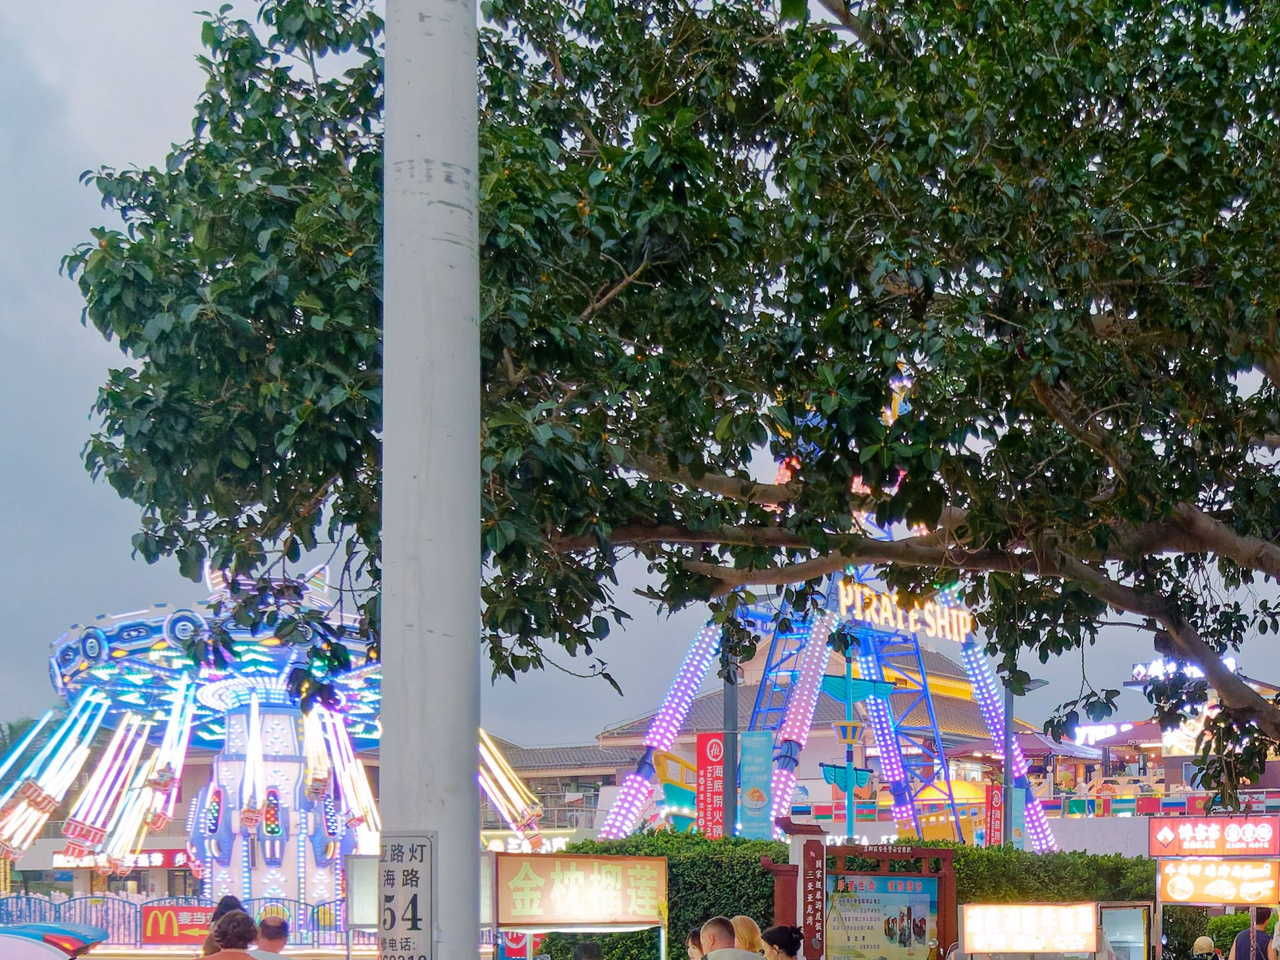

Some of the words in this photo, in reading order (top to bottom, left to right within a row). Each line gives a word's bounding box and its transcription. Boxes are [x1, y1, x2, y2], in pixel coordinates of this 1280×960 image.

[923, 600, 972, 642] SHIP
[712, 765, 723, 838] 海底捞火锅
[382, 893, 423, 931] 54
[508, 861, 659, 917] 金枕榴莲
